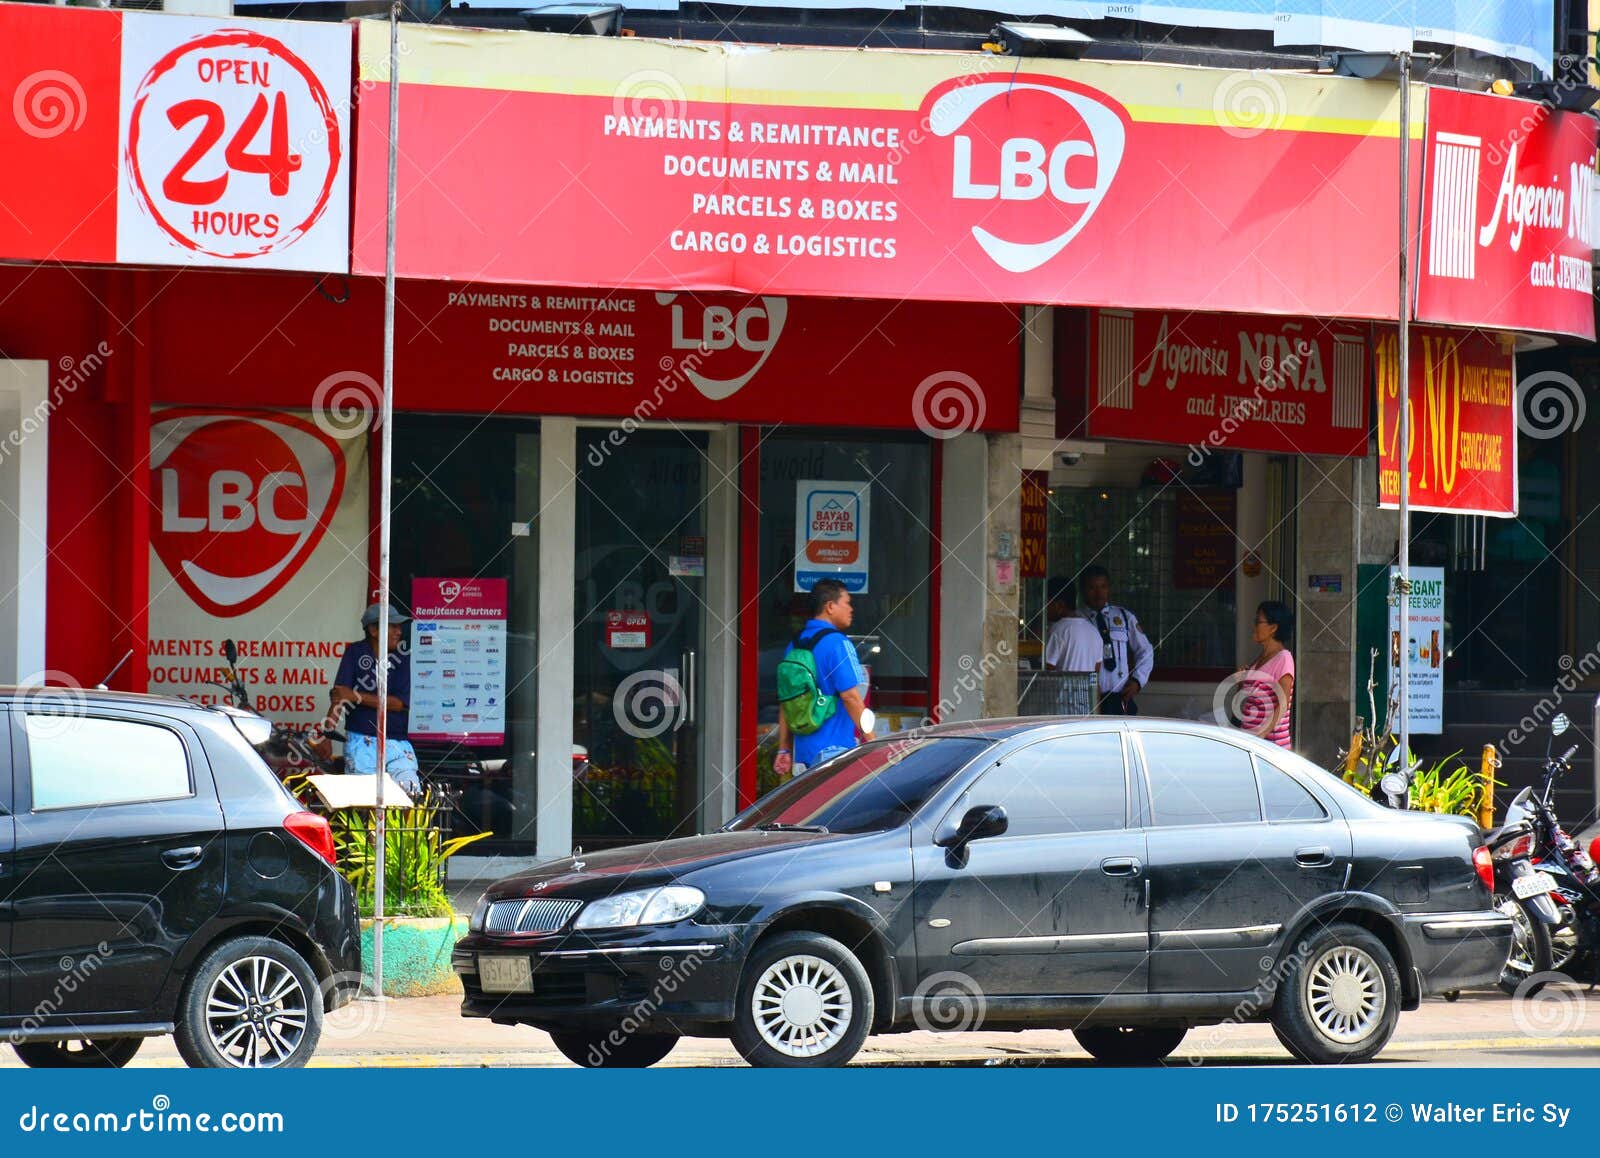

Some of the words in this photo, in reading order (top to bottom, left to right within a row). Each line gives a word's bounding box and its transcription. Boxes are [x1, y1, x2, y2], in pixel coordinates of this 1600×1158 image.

[198, 57, 270, 88] OPEN
[604, 115, 721, 140] PAYMENTS
[728, 121, 744, 142] &
[751, 122, 899, 148] REMITTANCE
[162, 90, 302, 206] 24
[664, 155, 809, 181] DOCUMENTS
[816, 162, 832, 182] &
[839, 162, 898, 184] MAIL
[953, 134, 1098, 204] LBC
[693, 193, 791, 218] PARCELS
[798, 199, 814, 219] &
[821, 199, 897, 222] BOXES
[1479, 141, 1564, 252] Agencia
[192, 210, 279, 238] HOURS
[670, 230, 747, 254] CARGO
[753, 234, 770, 255] &
[777, 234, 897, 258] LOGISTICS
[1531, 254, 1555, 287] and
[448, 293, 527, 308] PAYMENTS
[531, 297, 541, 309] &
[547, 297, 636, 312] REMITTANCE
[489, 318, 581, 335] DOCUMENTS
[584, 322, 595, 336] &
[599, 323, 635, 337] MAIL
[670, 304, 770, 353] LBC
[508, 343, 569, 358] PARCELS
[573, 346, 584, 359] &
[588, 347, 635, 361] BOXES
[1137, 314, 1229, 391] Agencia
[1238, 322, 1327, 393] NIÑA
[492, 367, 544, 382] CARGO
[548, 369, 558, 382] &
[563, 370, 634, 385] LOGISTICS
[1461, 365, 1488, 404] ADVANCE
[1186, 393, 1215, 416] and
[1220, 395, 1306, 425] JEWELRIES
[1460, 431, 1483, 470] SERVICE
[162, 468, 307, 535] LBC
[816, 511, 850, 521] BAYAD
[812, 521, 854, 531] CENTER
[416, 606, 465, 616] Remittance
[466, 607, 502, 616] Partners
[1423, 597, 1442, 609] SHOP
[149, 640, 213, 656] MENTS
[265, 668, 277, 684] &
[283, 668, 328, 685] MAIL
[256, 695, 315, 712] BOXES
